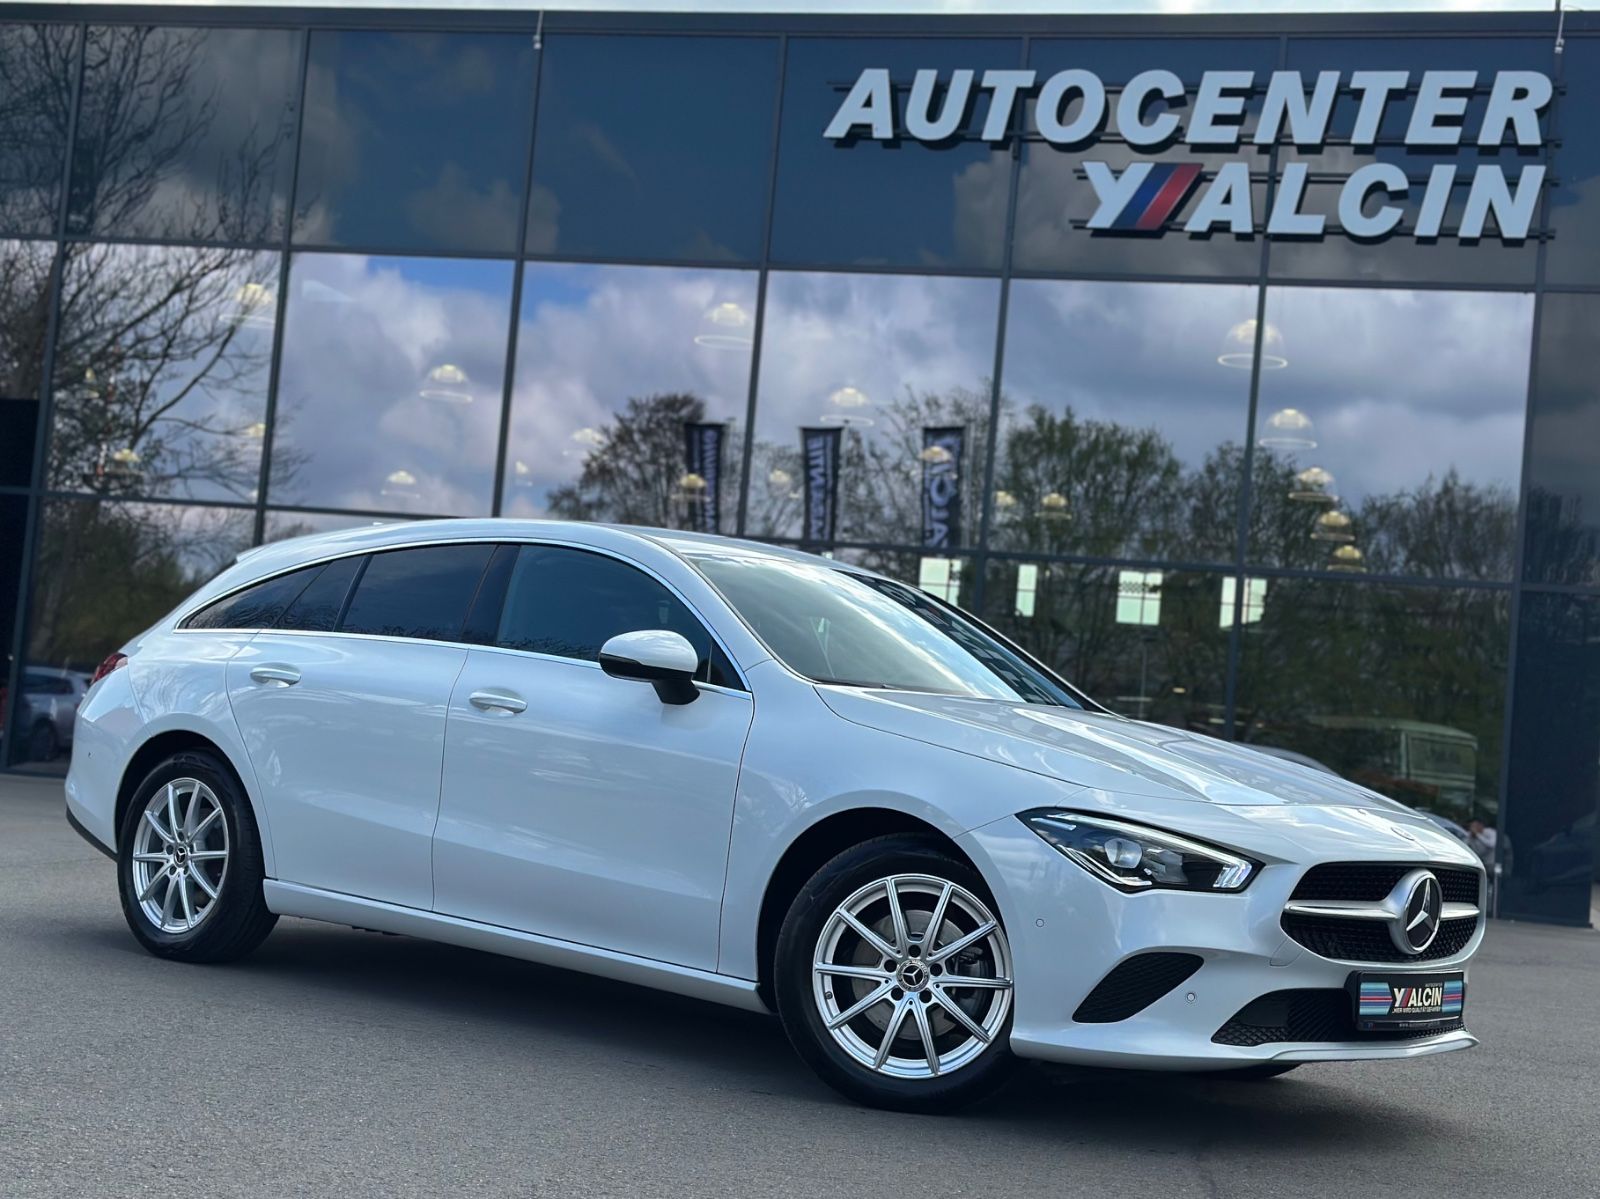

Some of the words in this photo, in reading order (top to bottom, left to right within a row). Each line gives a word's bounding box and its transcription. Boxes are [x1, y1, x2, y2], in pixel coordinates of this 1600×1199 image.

[822, 68, 1553, 146] AUTOCENTER
[1082, 161, 1546, 239] YALCIN
[1393, 987, 1442, 1007] YALCIN
